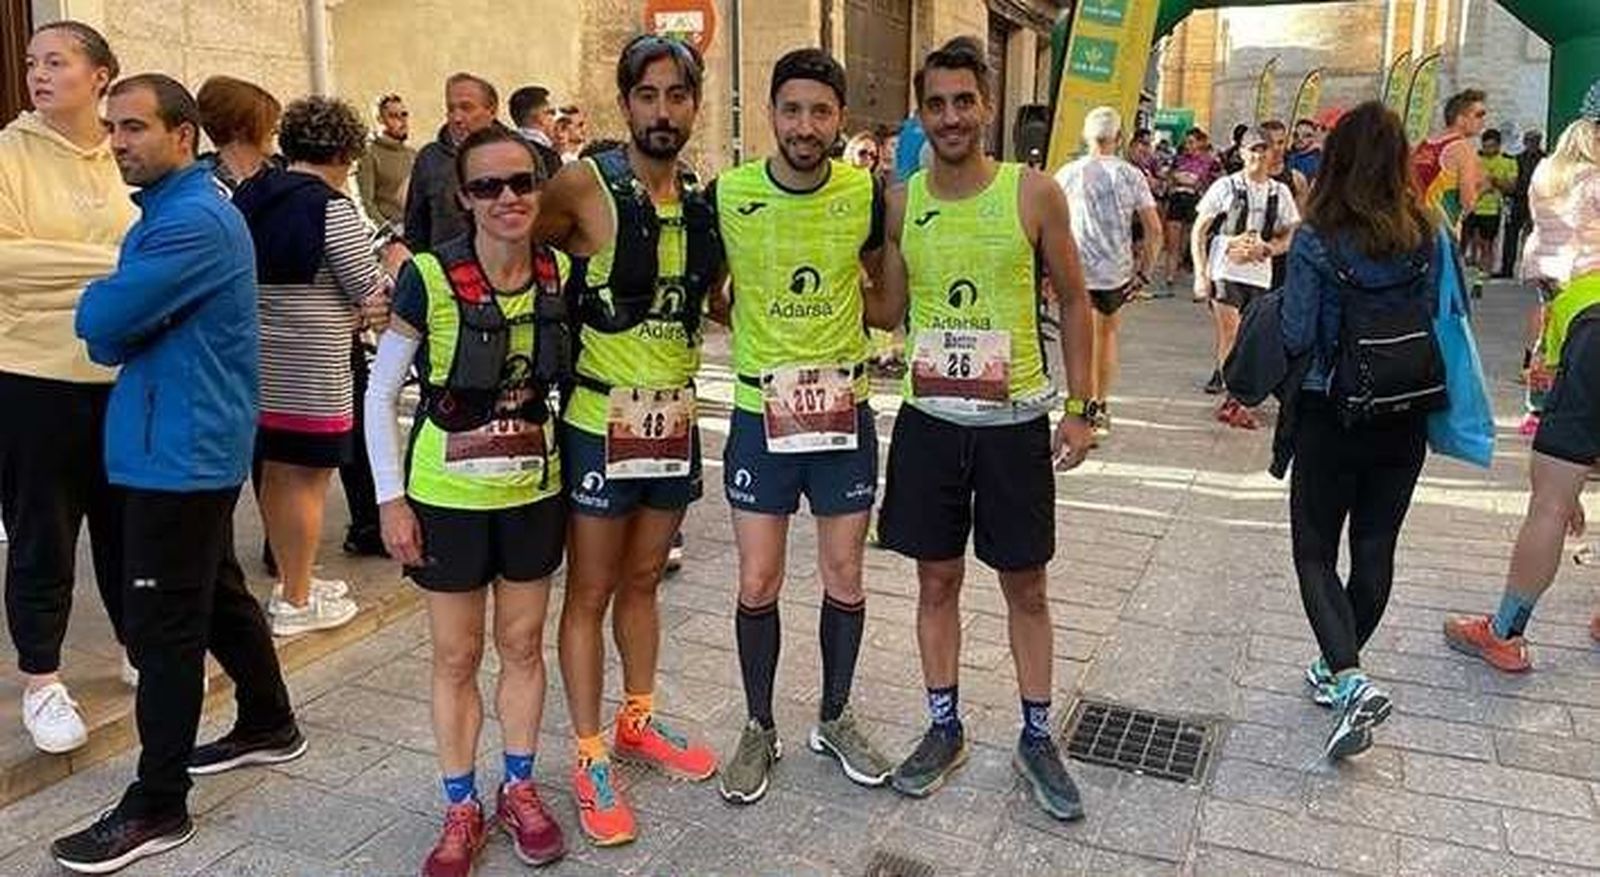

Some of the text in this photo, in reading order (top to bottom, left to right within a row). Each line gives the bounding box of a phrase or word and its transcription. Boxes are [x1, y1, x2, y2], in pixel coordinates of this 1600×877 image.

[770, 301, 832, 318] Adarsa
[948, 353, 970, 378] 26
[793, 388, 825, 412] 207
